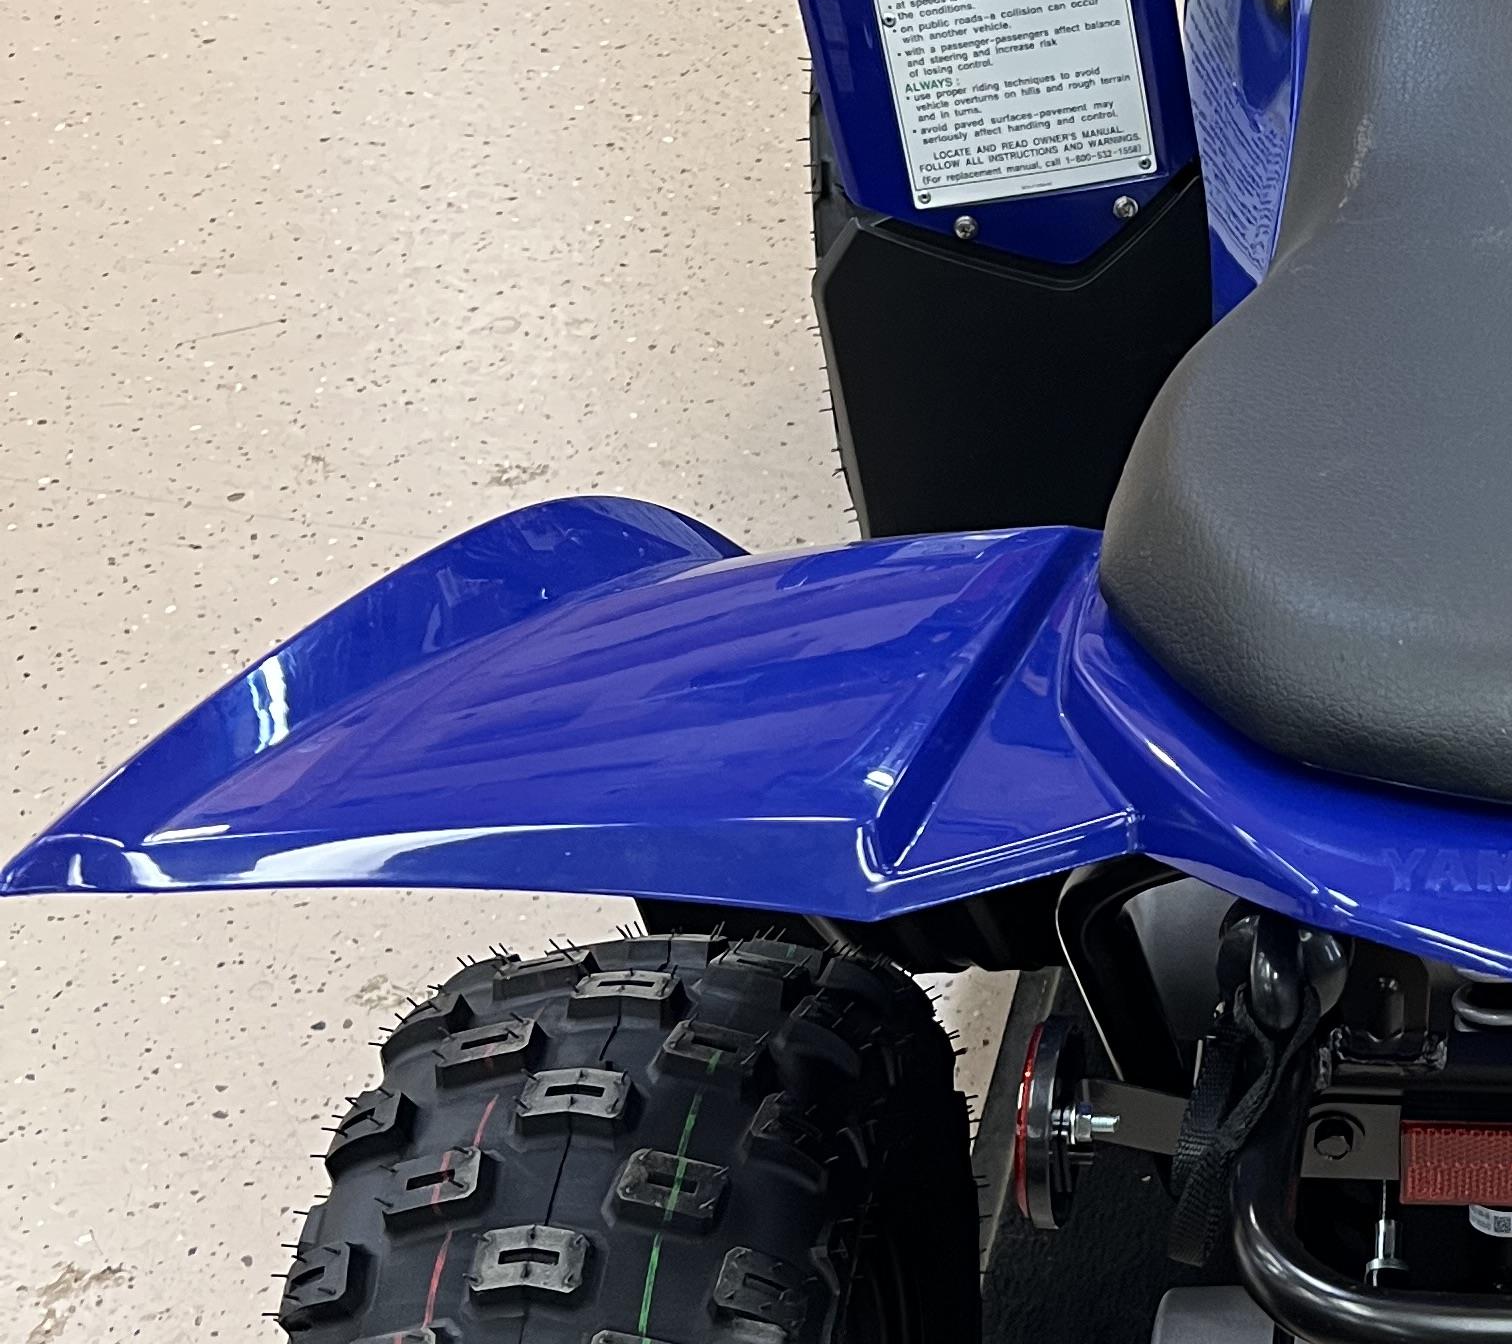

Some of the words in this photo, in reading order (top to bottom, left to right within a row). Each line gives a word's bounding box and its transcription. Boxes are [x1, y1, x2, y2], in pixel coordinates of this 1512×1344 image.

[895, 0, 905, 9] at
[897, 10, 913, 20] the
[899, 24, 913, 33] on
[917, 18, 950, 32] public
[1000, 5, 1043, 18] collision
[1047, 2, 1065, 11] can
[901, 33, 923, 44] with
[928, 27, 967, 40] another
[904, 46, 924, 56] with
[1053, 23, 1079, 34] affect
[1084, 17, 1120, 30] balance
[906, 57, 925, 67] and
[929, 51, 968, 66] steering
[972, 48, 990, 57] and
[994, 41, 1034, 54] increase
[1039, 37, 1057, 47] risk
[908, 69, 919, 77] of
[923, 64, 953, 77] losing
[913, 92, 931, 100] use
[935, 86, 967, 99] proper
[971, 81, 999, 93] riding
[1003, 72, 1055, 88] techniques
[1059, 70, 1070, 79] to
[1074, 65, 1100, 76] avoid
[918, 158, 961, 173] FOLLOW
[964, 155, 983, 165] ALL
[987, 144, 1058, 163] INSTRUCTIONS
[1062, 140, 1083, 151] AND
[932, 147, 970, 160] LOCATE
[975, 143, 996, 154] AND
[1000, 138, 1028, 150] READ
